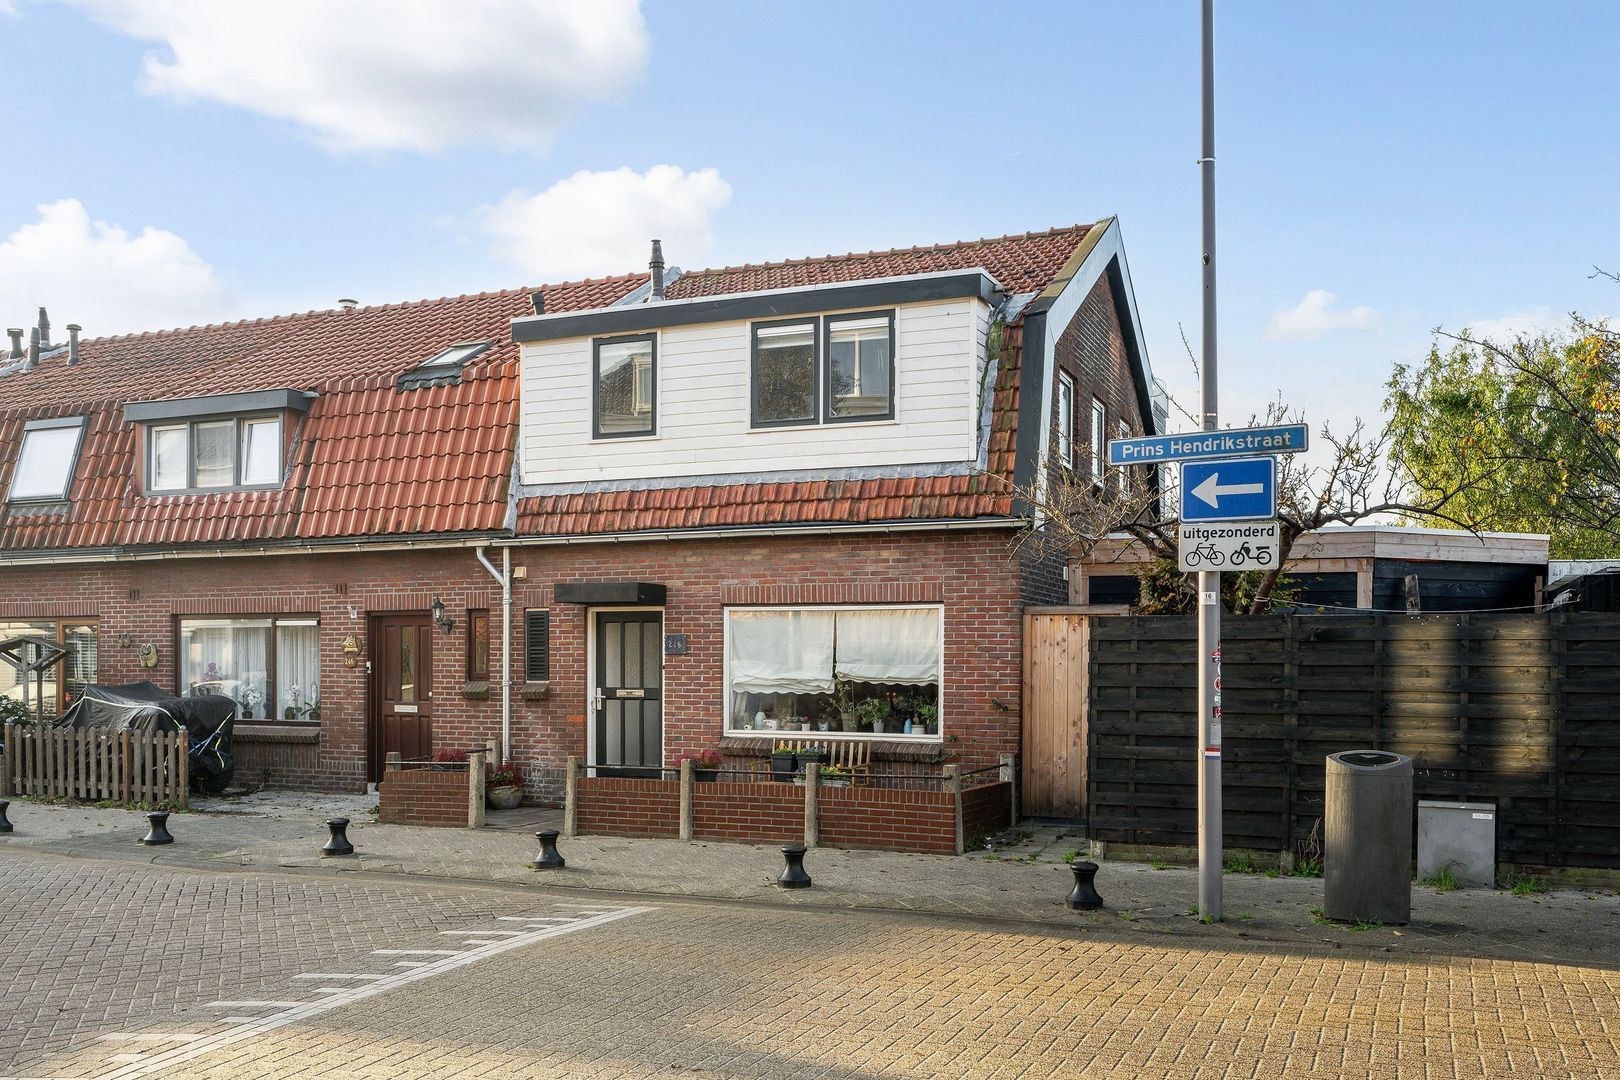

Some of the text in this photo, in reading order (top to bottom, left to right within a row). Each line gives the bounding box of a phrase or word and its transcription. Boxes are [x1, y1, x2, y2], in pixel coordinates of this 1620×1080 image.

[1122, 431, 1292, 458] Prins Hendrikstraat
[1183, 526, 1275, 541] uitgezonderd
